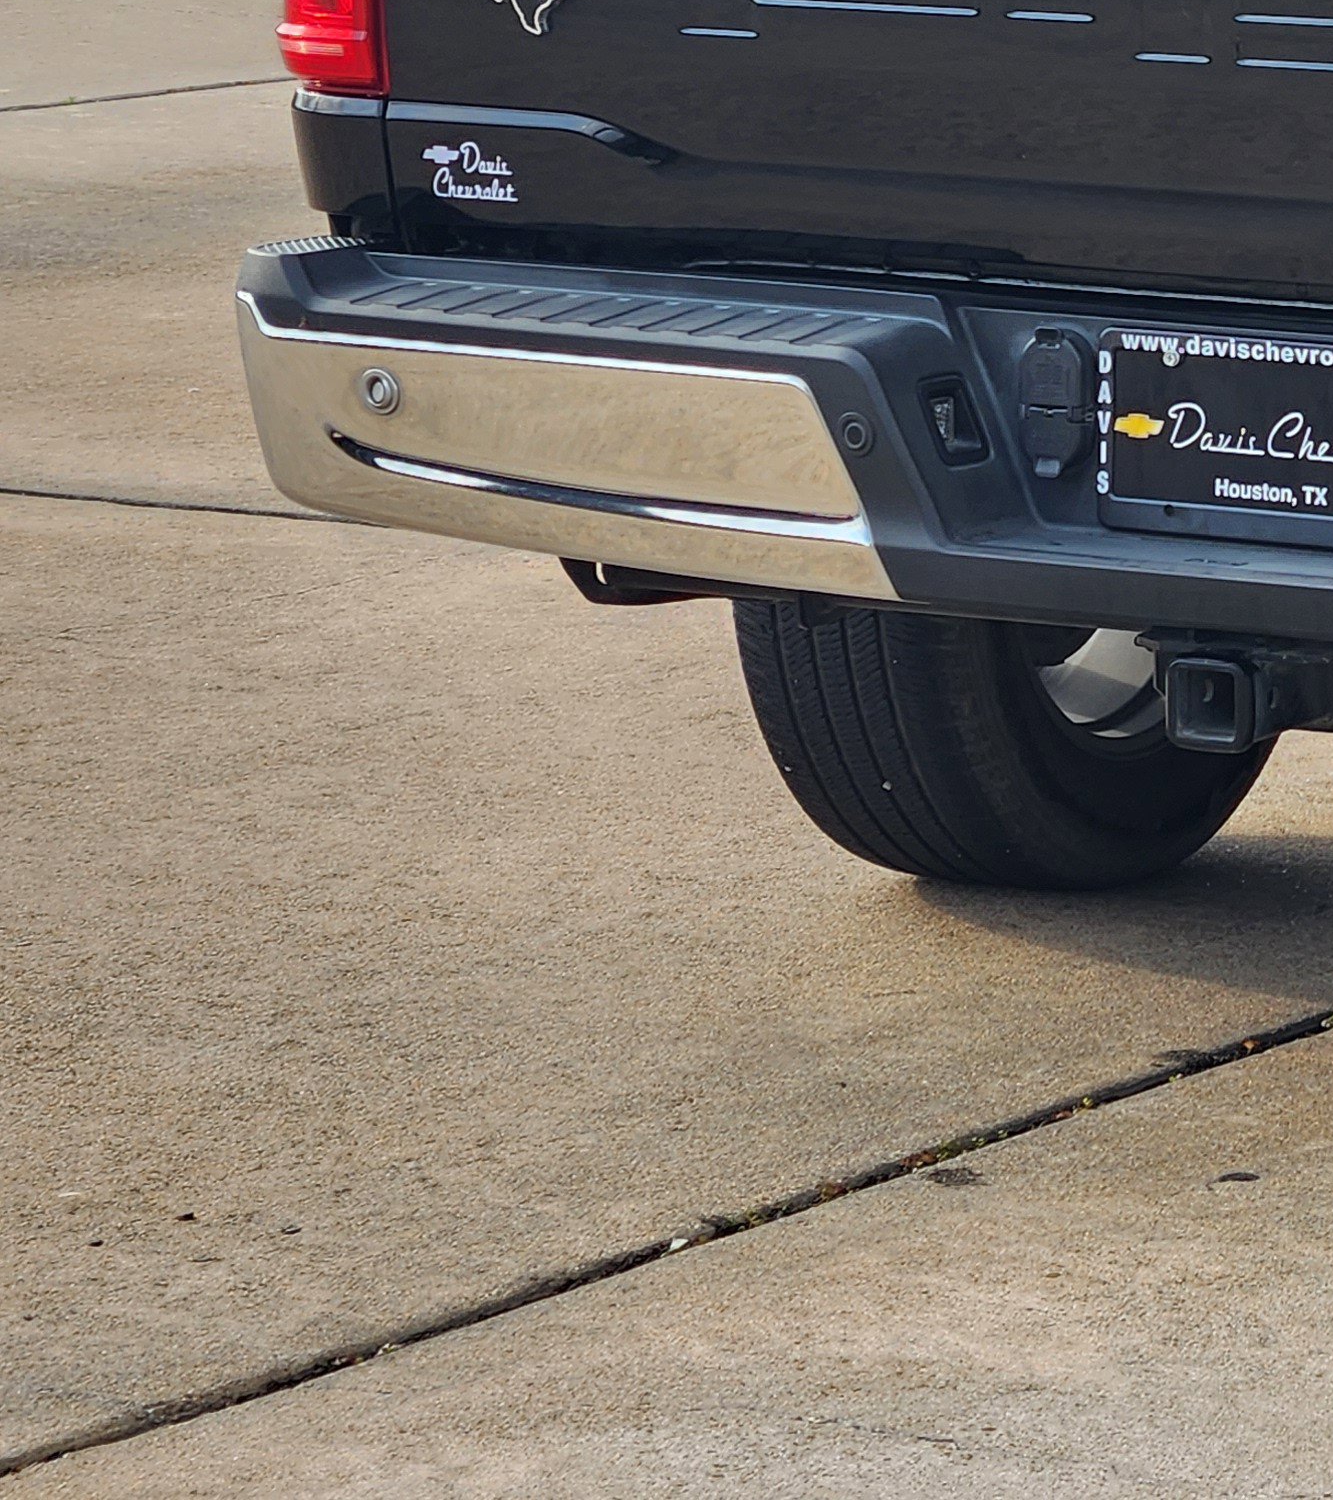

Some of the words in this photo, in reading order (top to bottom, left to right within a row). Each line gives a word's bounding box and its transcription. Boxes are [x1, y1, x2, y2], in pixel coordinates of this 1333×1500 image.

[459, 141, 513, 176] Davis
[432, 166, 519, 203] Chevrolet
[1096, 350, 1113, 494] DAVIS
[1167, 401, 1266, 456] Davis
[1214, 477, 1298, 507] Houston,
[1301, 485, 1329, 507] TX
